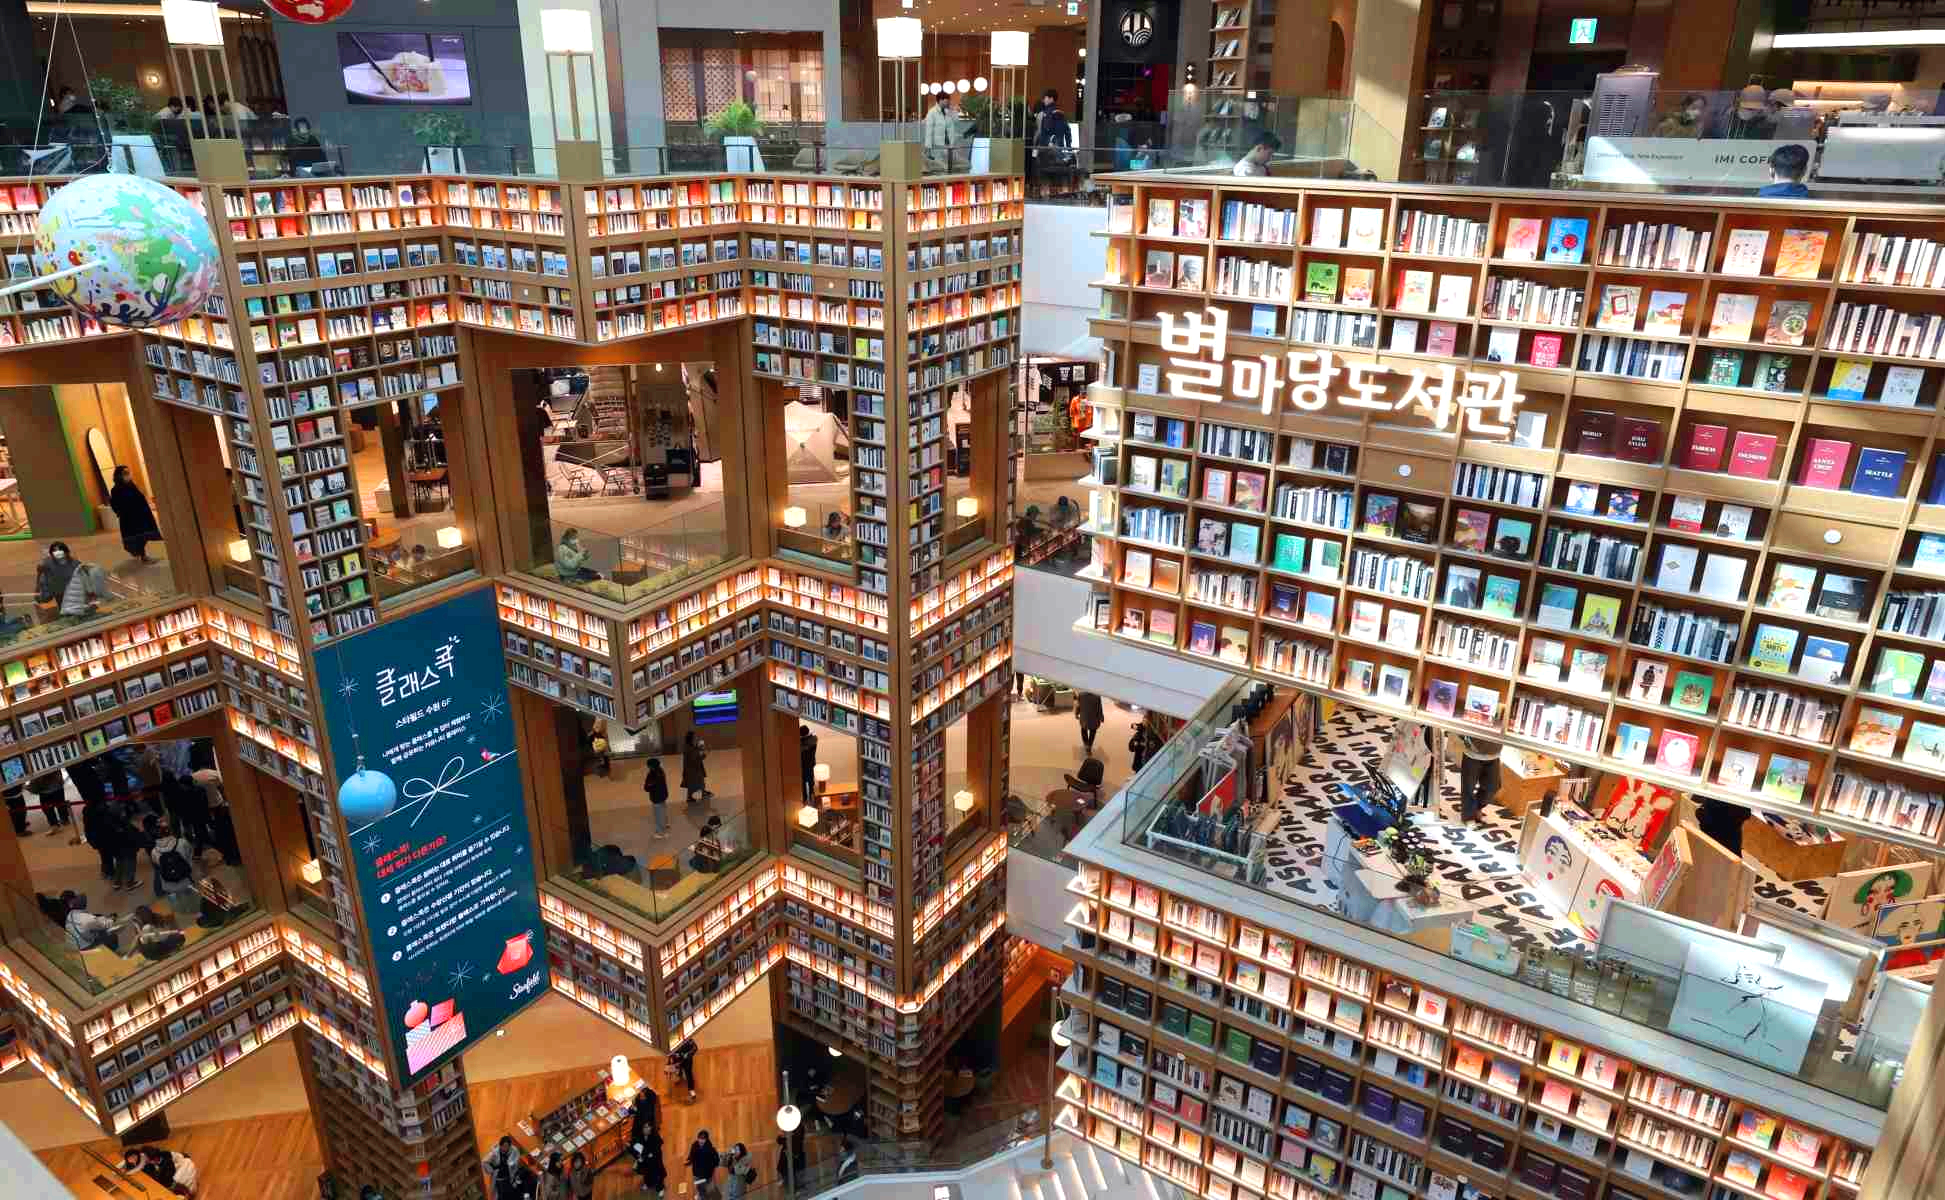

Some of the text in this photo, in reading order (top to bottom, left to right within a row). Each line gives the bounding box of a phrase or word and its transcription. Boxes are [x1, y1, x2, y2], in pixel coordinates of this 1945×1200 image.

[1715, 154, 1770, 164] IMI COF
[1156, 306, 1526, 435] 별마당도서관
[376, 641, 456, 707] 클래스콕
[395, 710, 424, 727] 스타필드
[1264, 831, 1317, 893] ASPIR
[1441, 826, 1553, 919] ASPIRING
